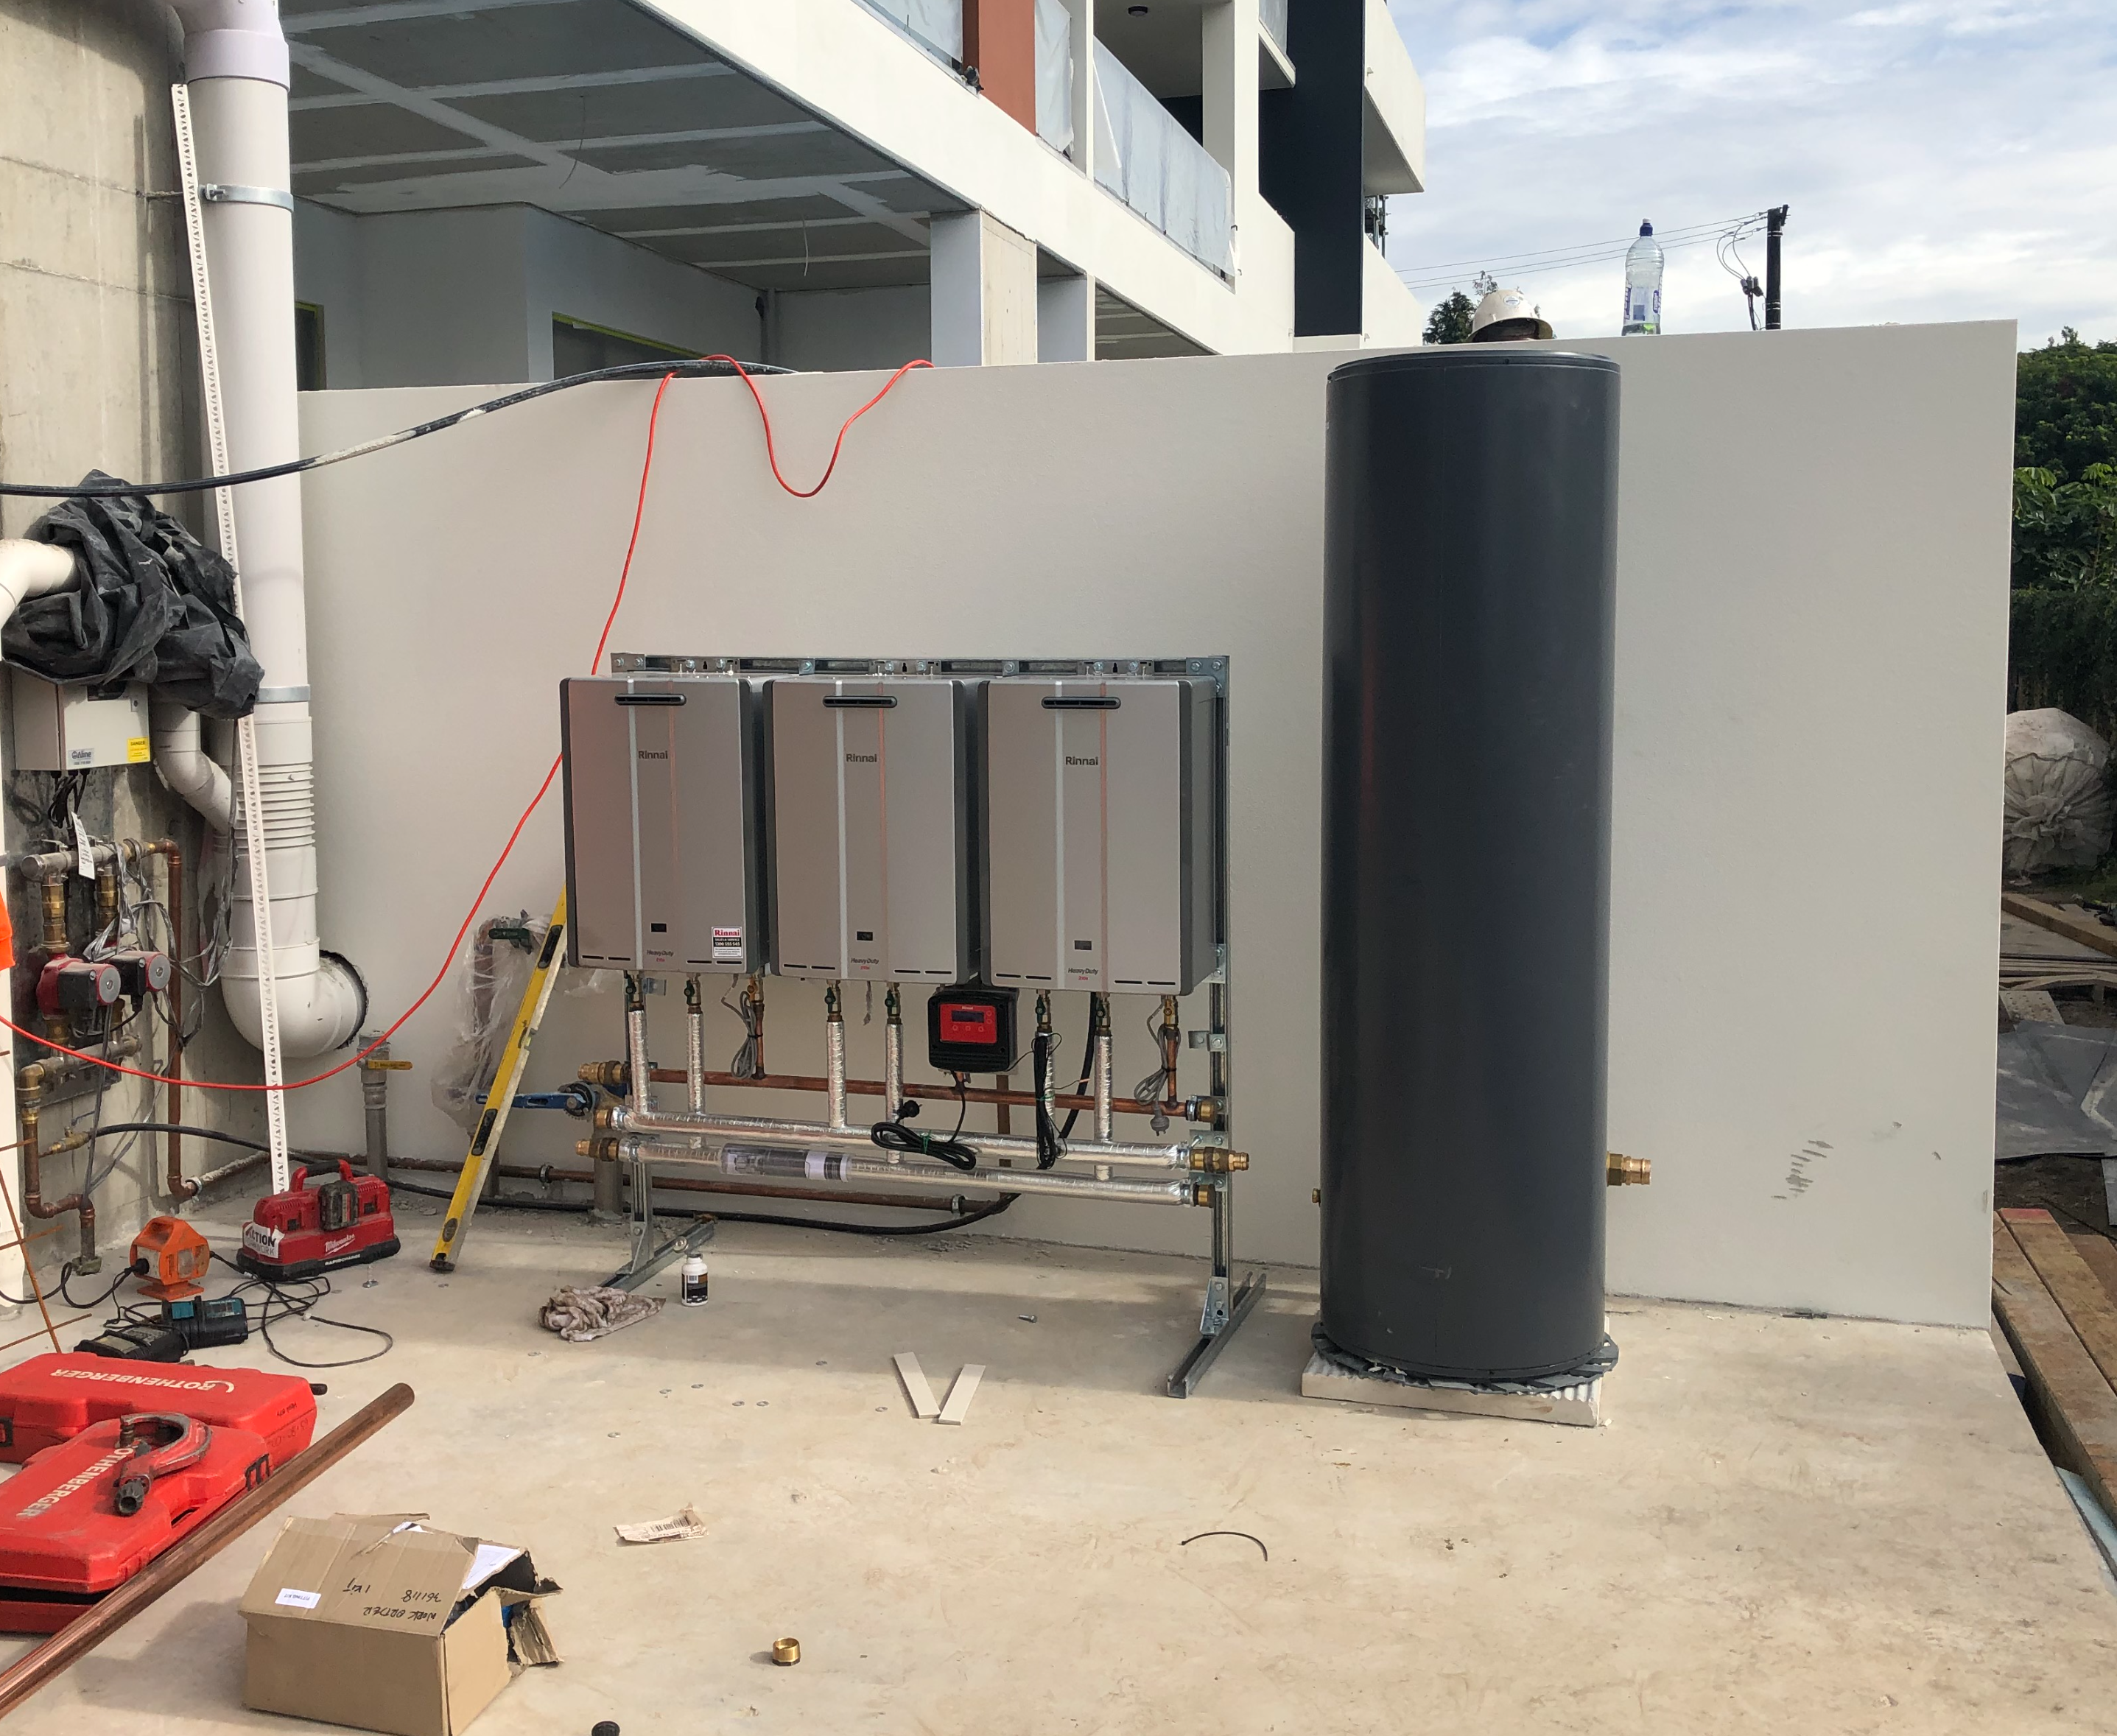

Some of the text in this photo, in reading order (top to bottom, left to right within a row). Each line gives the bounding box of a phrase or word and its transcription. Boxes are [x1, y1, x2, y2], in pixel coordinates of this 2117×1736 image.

[638, 750, 668, 759] Rinnai
[846, 753, 877, 762] Rinnai
[1065, 756, 1098, 766] Rinnai
[50, 1368, 234, 1393] ROTHENBERGER
[401, 1589, 442, 1603] 361118
[363, 1606, 438, 1621] WORK ORDER
